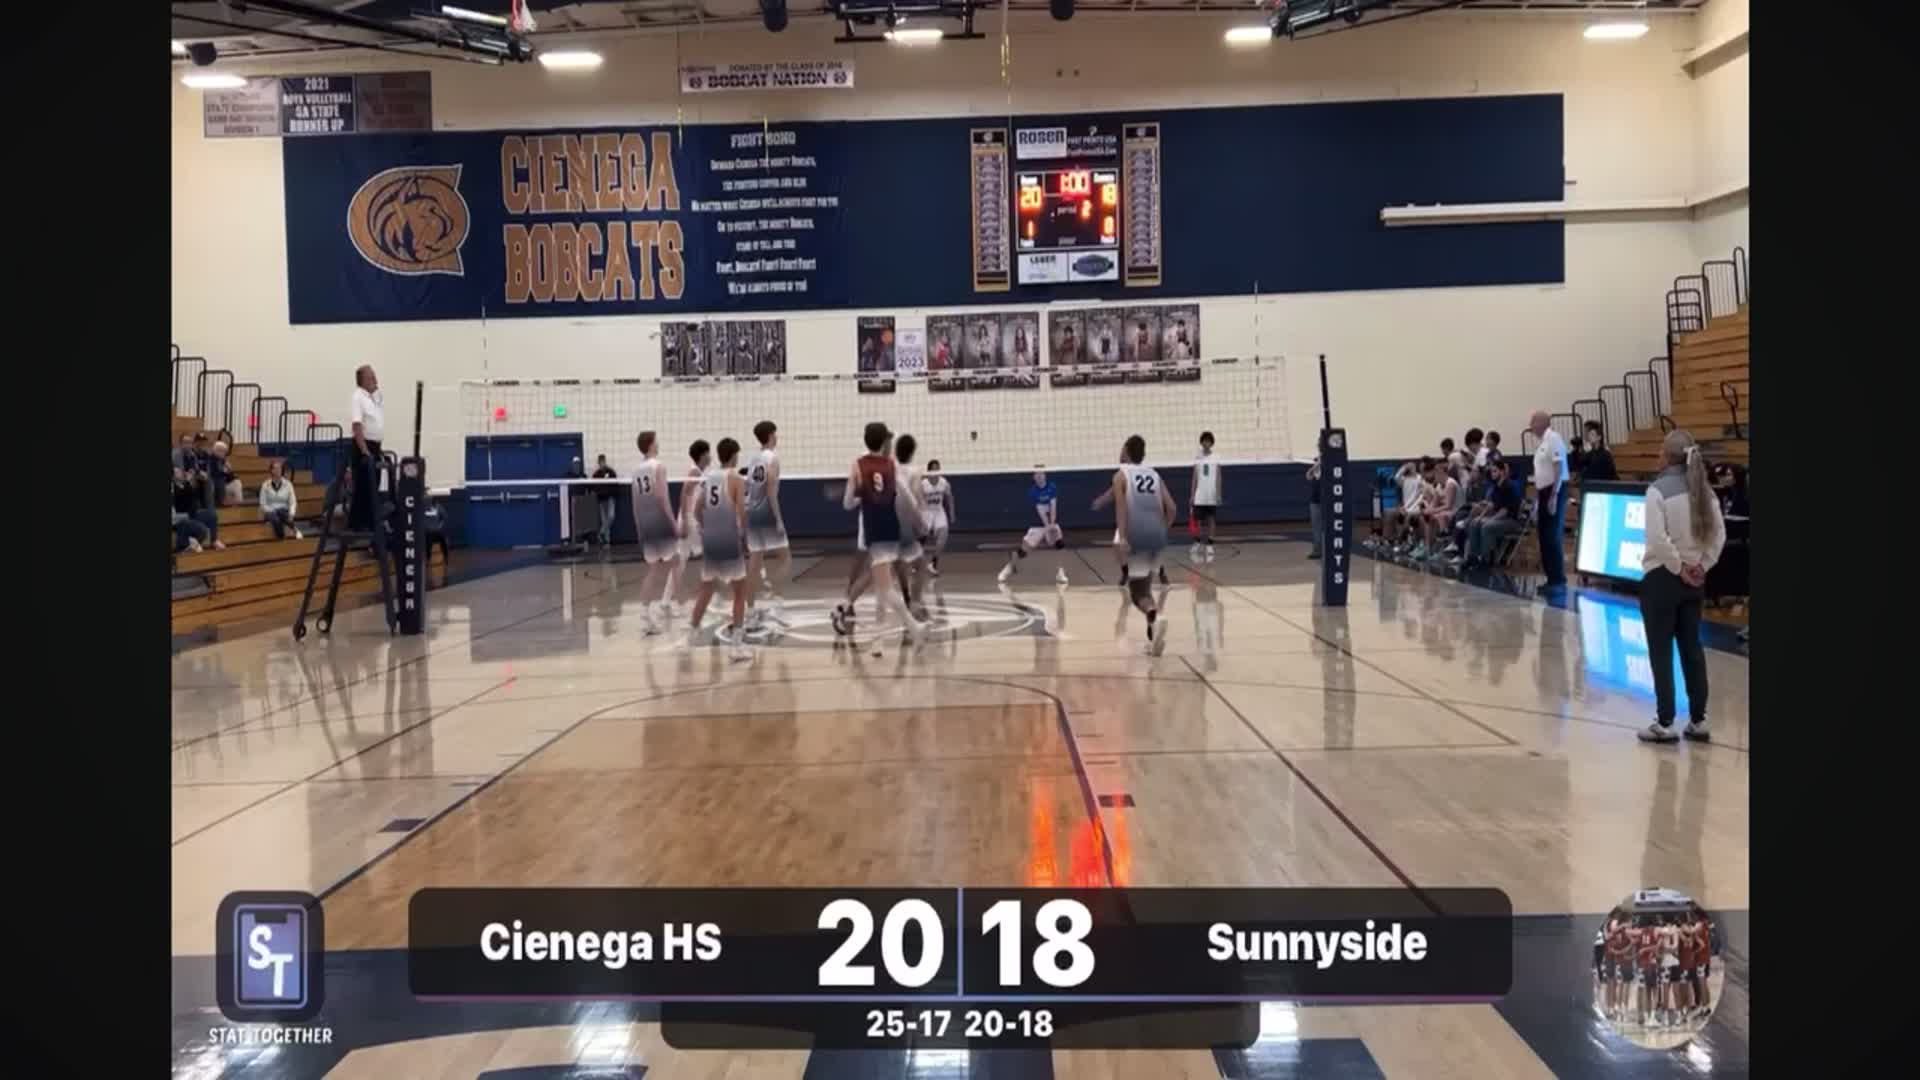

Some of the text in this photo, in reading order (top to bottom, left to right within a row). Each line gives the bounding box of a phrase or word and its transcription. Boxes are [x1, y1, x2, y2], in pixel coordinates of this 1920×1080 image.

[304, 77, 329, 91] 2021
[708, 72, 828, 89] BOBCAT NATION
[306, 93, 352, 104] VOLLEYBALL
[312, 105, 340, 118] STATE
[290, 119, 329, 133] RUNNER
[331, 119, 345, 132] UP
[502, 132, 680, 214] CIENEGA
[1020, 186, 1041, 208] 20
[1081, 199, 1091, 218] 2
[504, 220, 685, 303] BOBCATS
[899, 358, 924, 369] 2023
[752, 465, 765, 482] 40
[636, 475, 650, 494] 13
[1135, 475, 1155, 494] 22
[709, 485, 718, 505] 5
[1333, 467, 1344, 585] BOBCATS
[405, 496, 415, 609] CIENEGA
